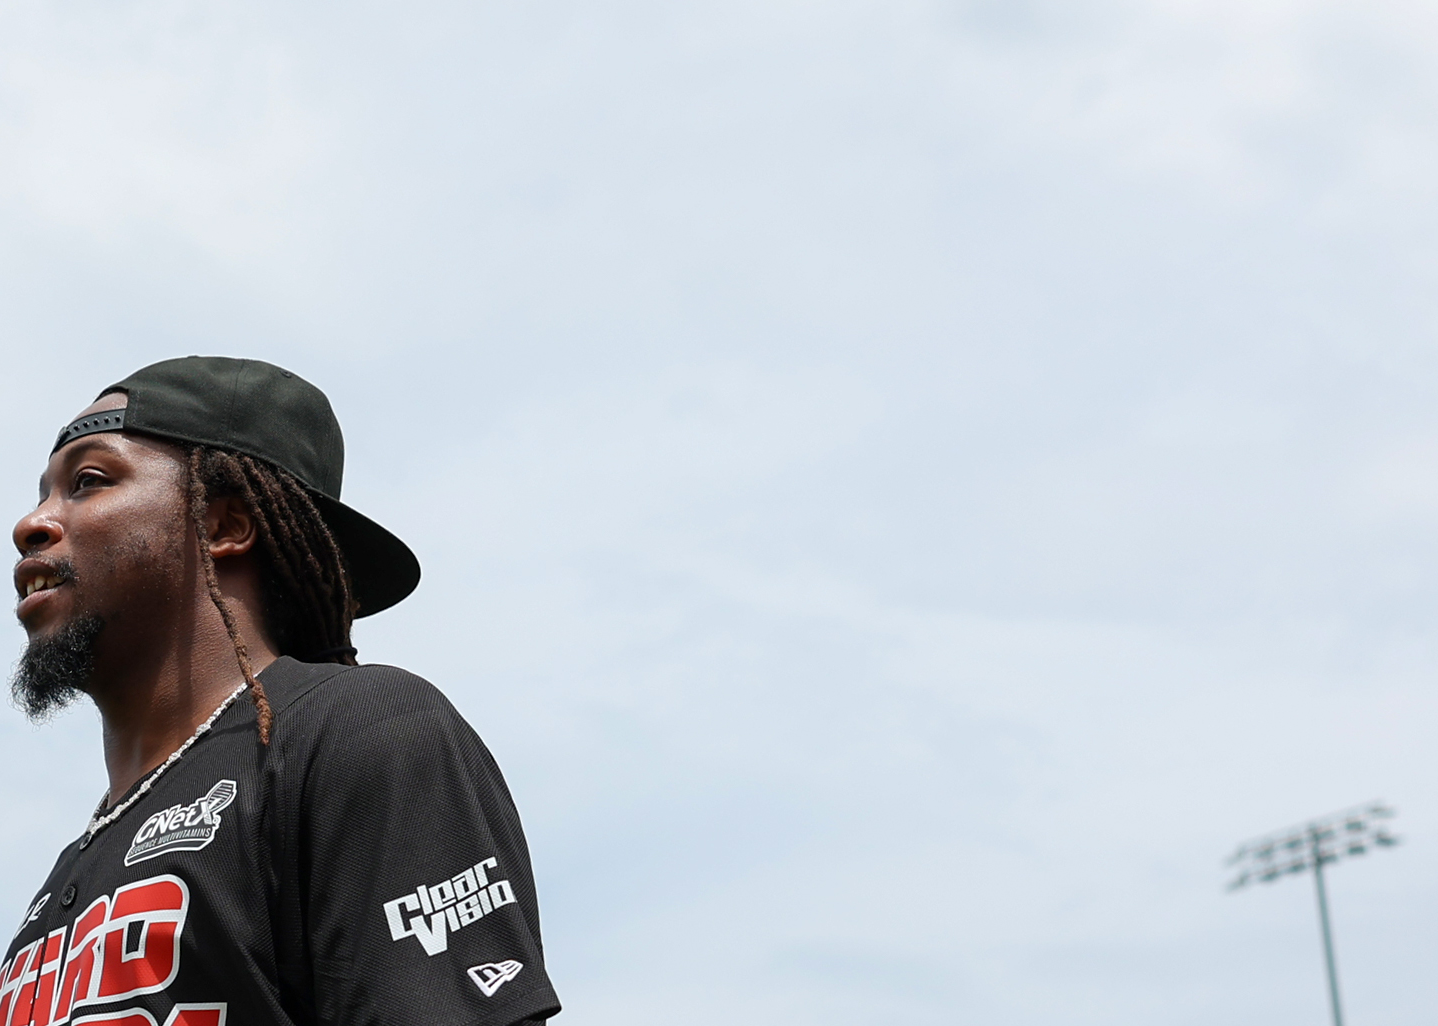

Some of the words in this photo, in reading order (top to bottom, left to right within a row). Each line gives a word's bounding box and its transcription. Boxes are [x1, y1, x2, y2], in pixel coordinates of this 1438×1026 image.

[158, 827, 212, 844] MULTIVITAMINS
[383, 857, 498, 941] Clear
[409, 879, 518, 957] Visio
